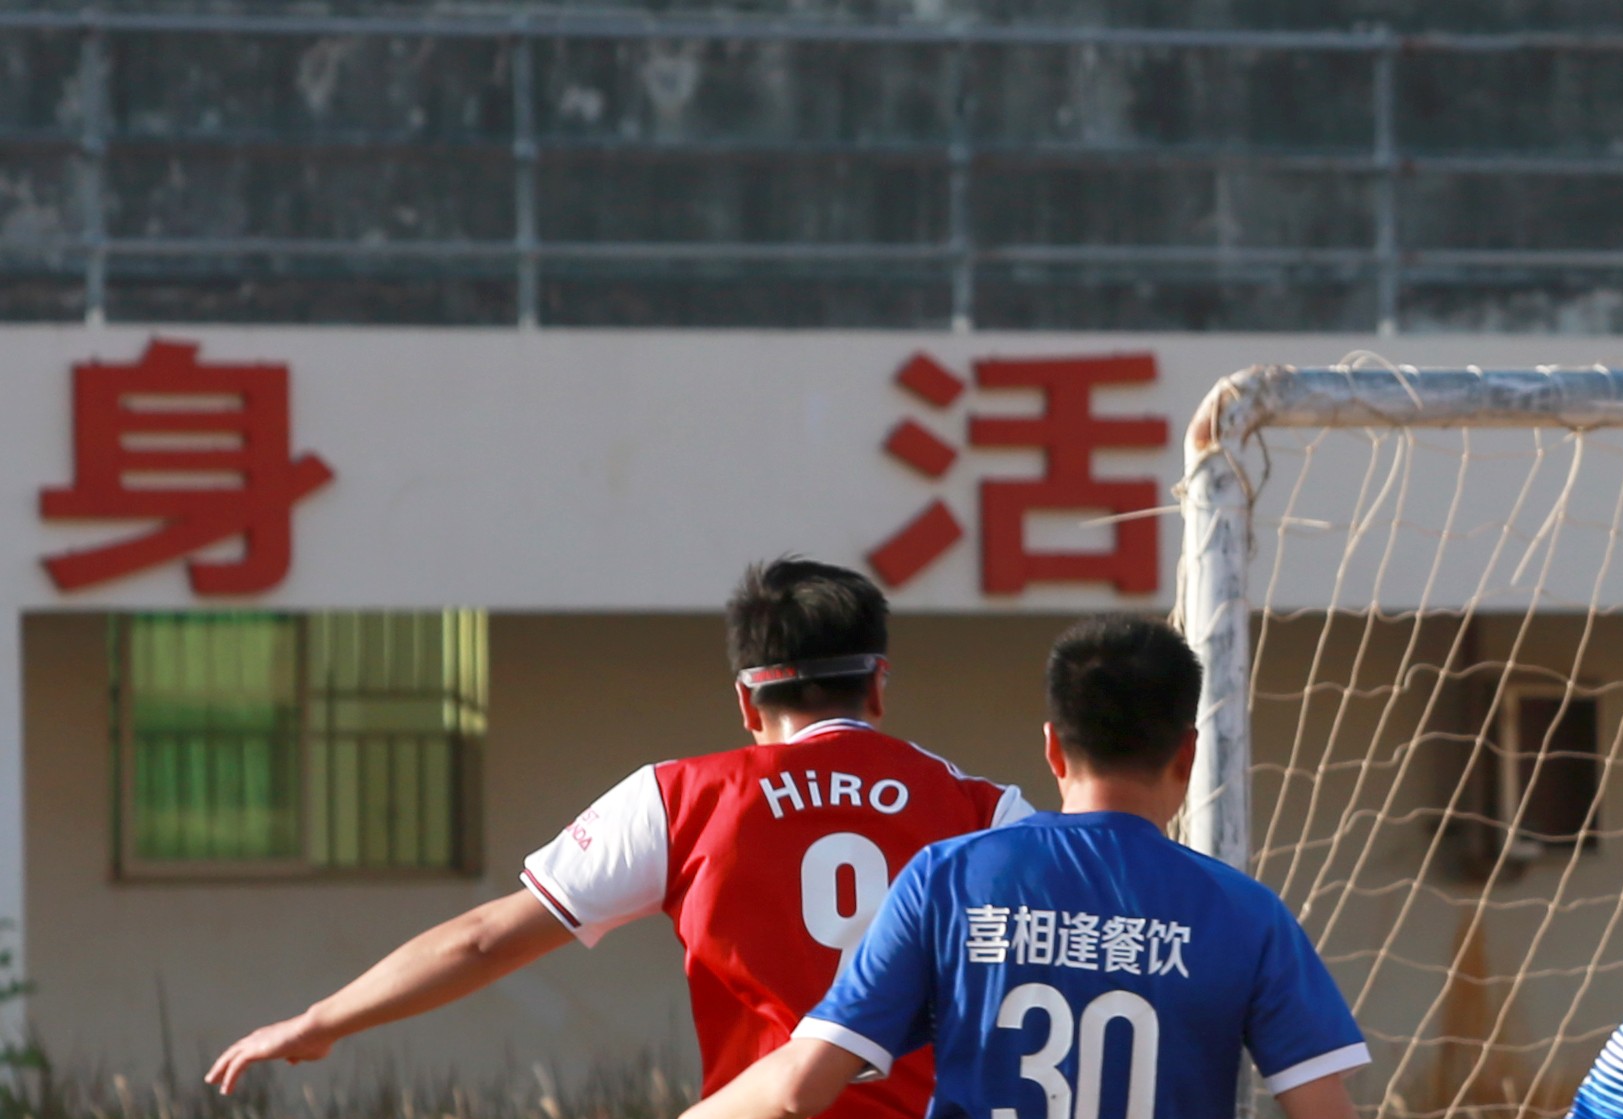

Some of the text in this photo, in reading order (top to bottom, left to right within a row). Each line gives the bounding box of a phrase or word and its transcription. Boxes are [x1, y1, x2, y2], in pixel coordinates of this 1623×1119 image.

[41, 338, 333, 596] 身
[866, 351, 1169, 597] 活
[801, 832, 888, 979] 9
[966, 903, 1192, 977] 喜相逢餐饮
